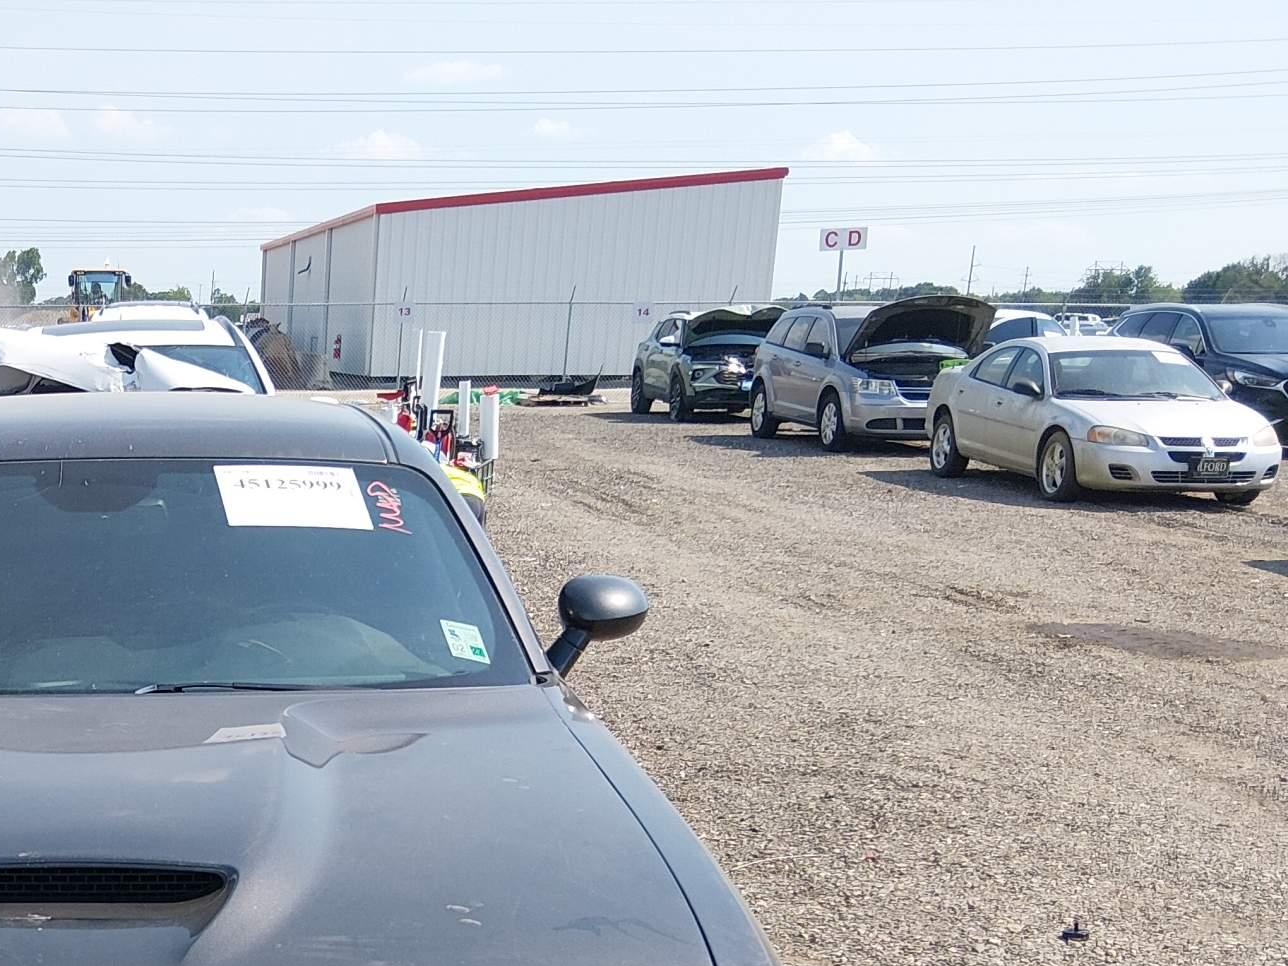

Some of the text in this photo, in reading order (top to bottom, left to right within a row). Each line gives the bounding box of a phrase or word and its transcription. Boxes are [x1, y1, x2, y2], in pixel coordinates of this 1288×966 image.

[825, 230, 861, 248] C D
[398, 307, 411, 316] 13
[638, 308, 650, 316] 14
[225, 478, 342, 490] 45125999
